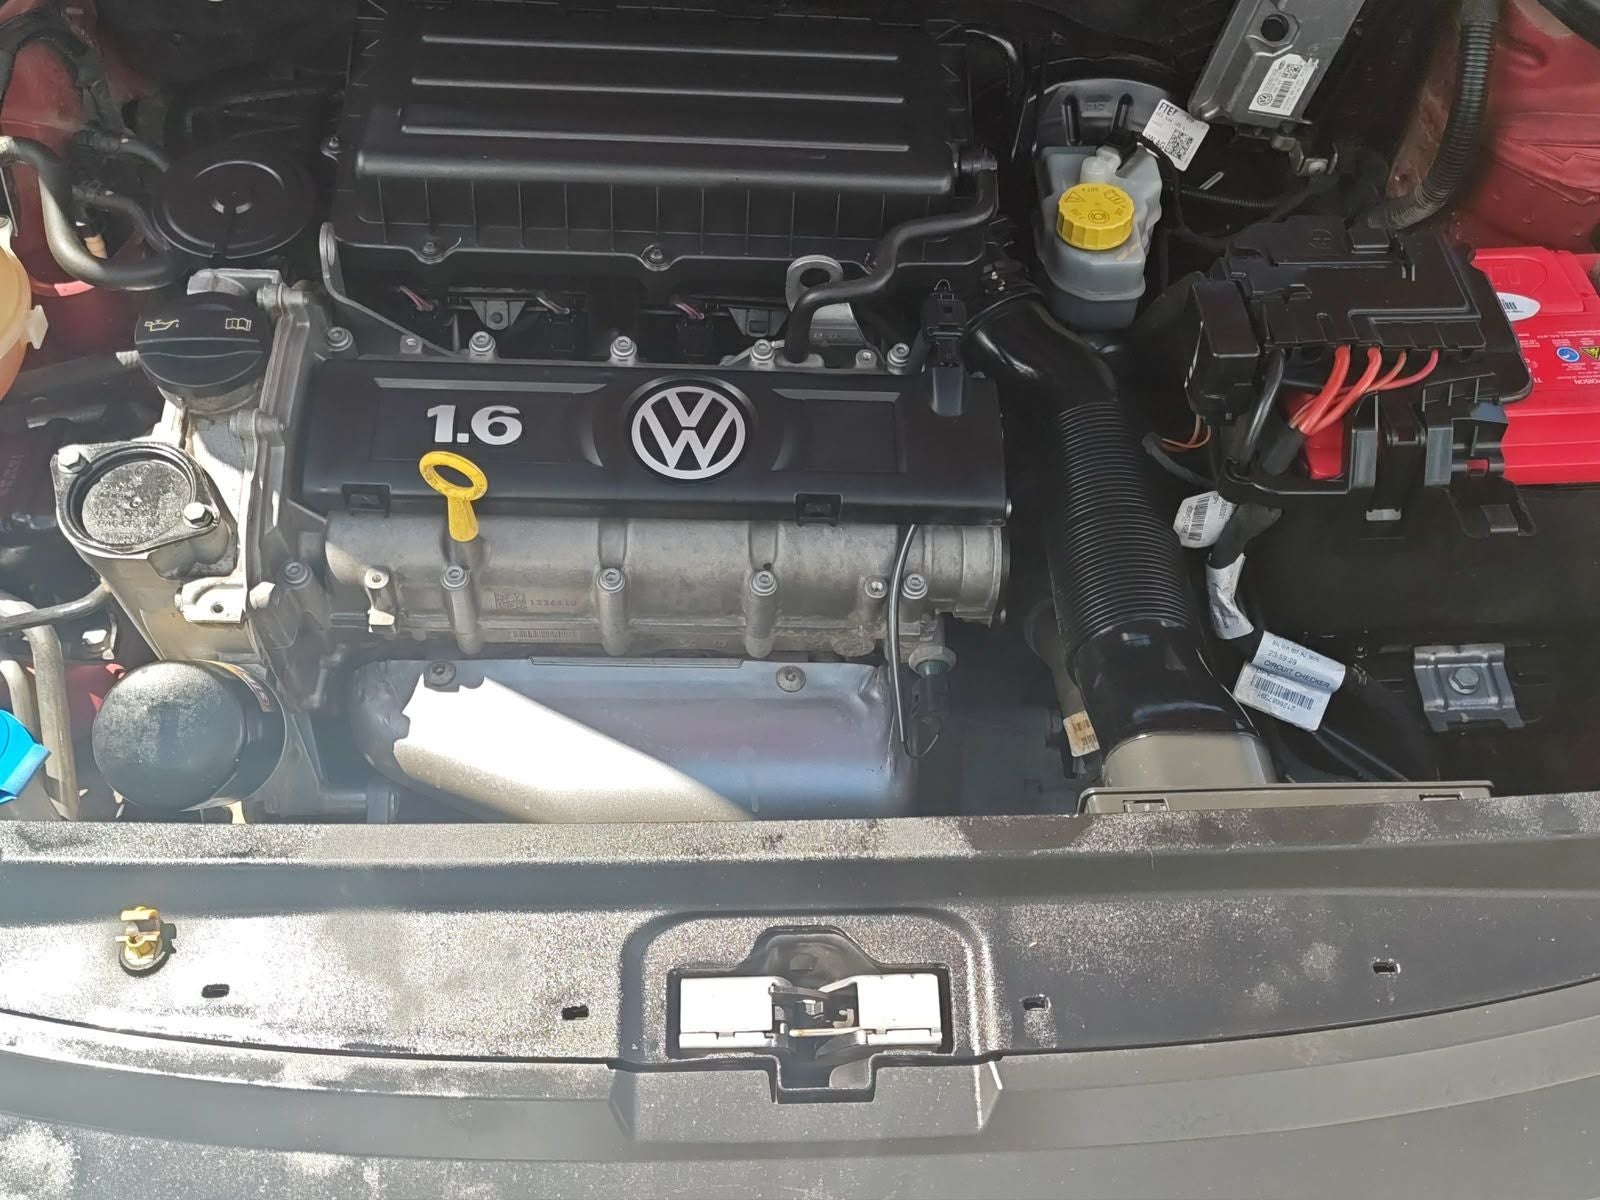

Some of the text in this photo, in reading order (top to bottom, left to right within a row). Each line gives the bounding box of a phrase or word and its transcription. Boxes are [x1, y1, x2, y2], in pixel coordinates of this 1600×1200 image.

[426, 404, 523, 446] 1.6
[1263, 659, 1294, 674] CIRCUIT
[1294, 671, 1330, 688] CHECKER
